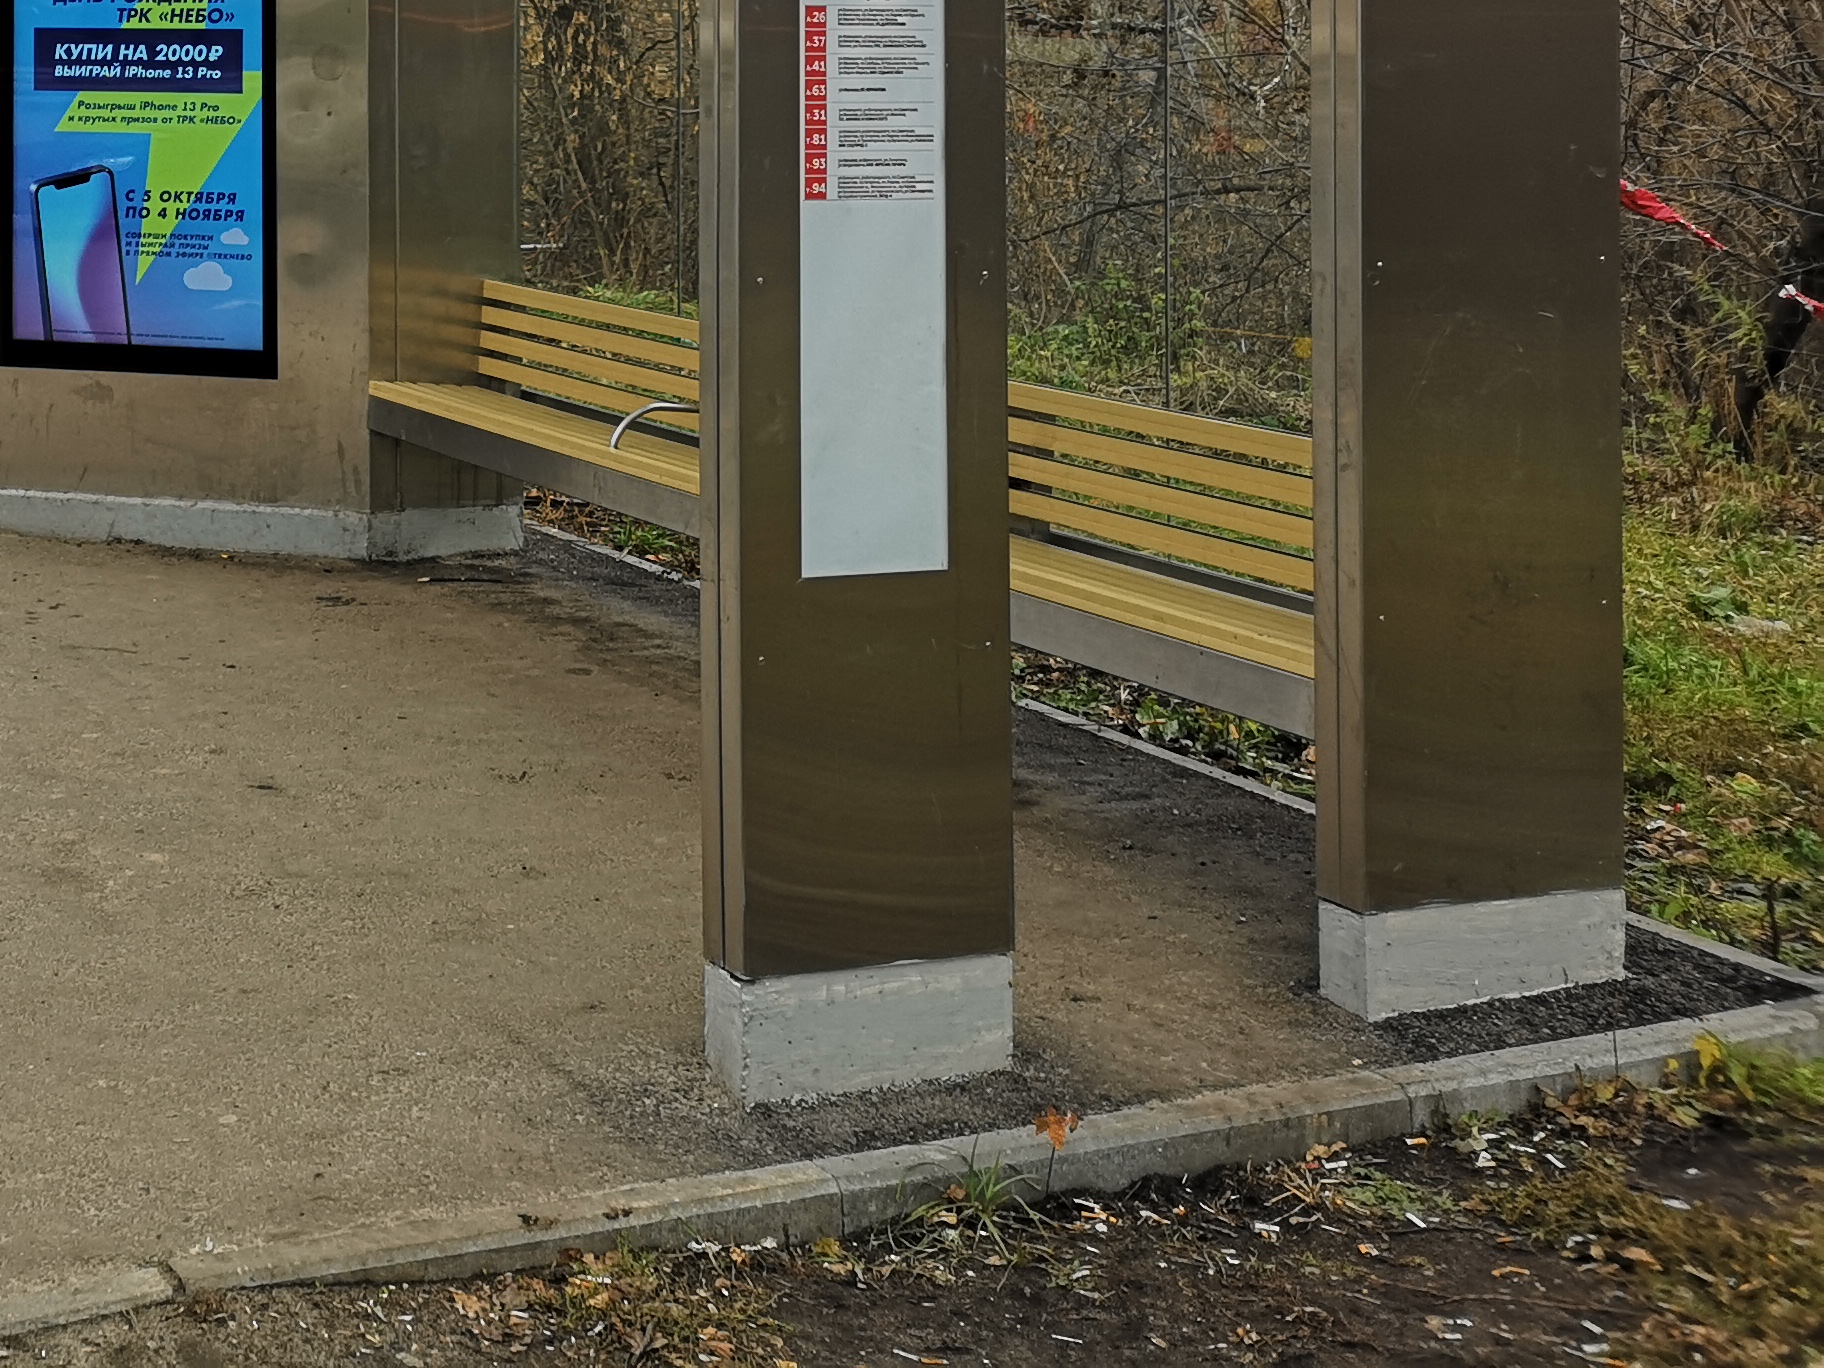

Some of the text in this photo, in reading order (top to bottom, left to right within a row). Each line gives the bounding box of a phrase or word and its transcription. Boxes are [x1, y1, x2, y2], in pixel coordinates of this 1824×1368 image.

[116, 7, 235, 24] ТРК «НЕБО»
[54, 43, 224, 62] КУПИ НА 2000₽
[54, 62, 222, 79] ВЫИГРАЙ iPhone 13 Pro
[77, 100, 220, 115] Розыгрыш iPhone 13 Pro
[67, 115, 242, 126] и крутых призов от ТРК «НЕБО»
[124, 189, 237, 205] С 5 ОКТЯБРЯ
[124, 206, 246, 222] ПО 4 НОЯБРЯ
[170, 233, 214, 242] ПОКУПКИ
[178, 242, 210, 251] ПРИЗЫ
[175, 251, 204, 260] ЭФИРЕ
